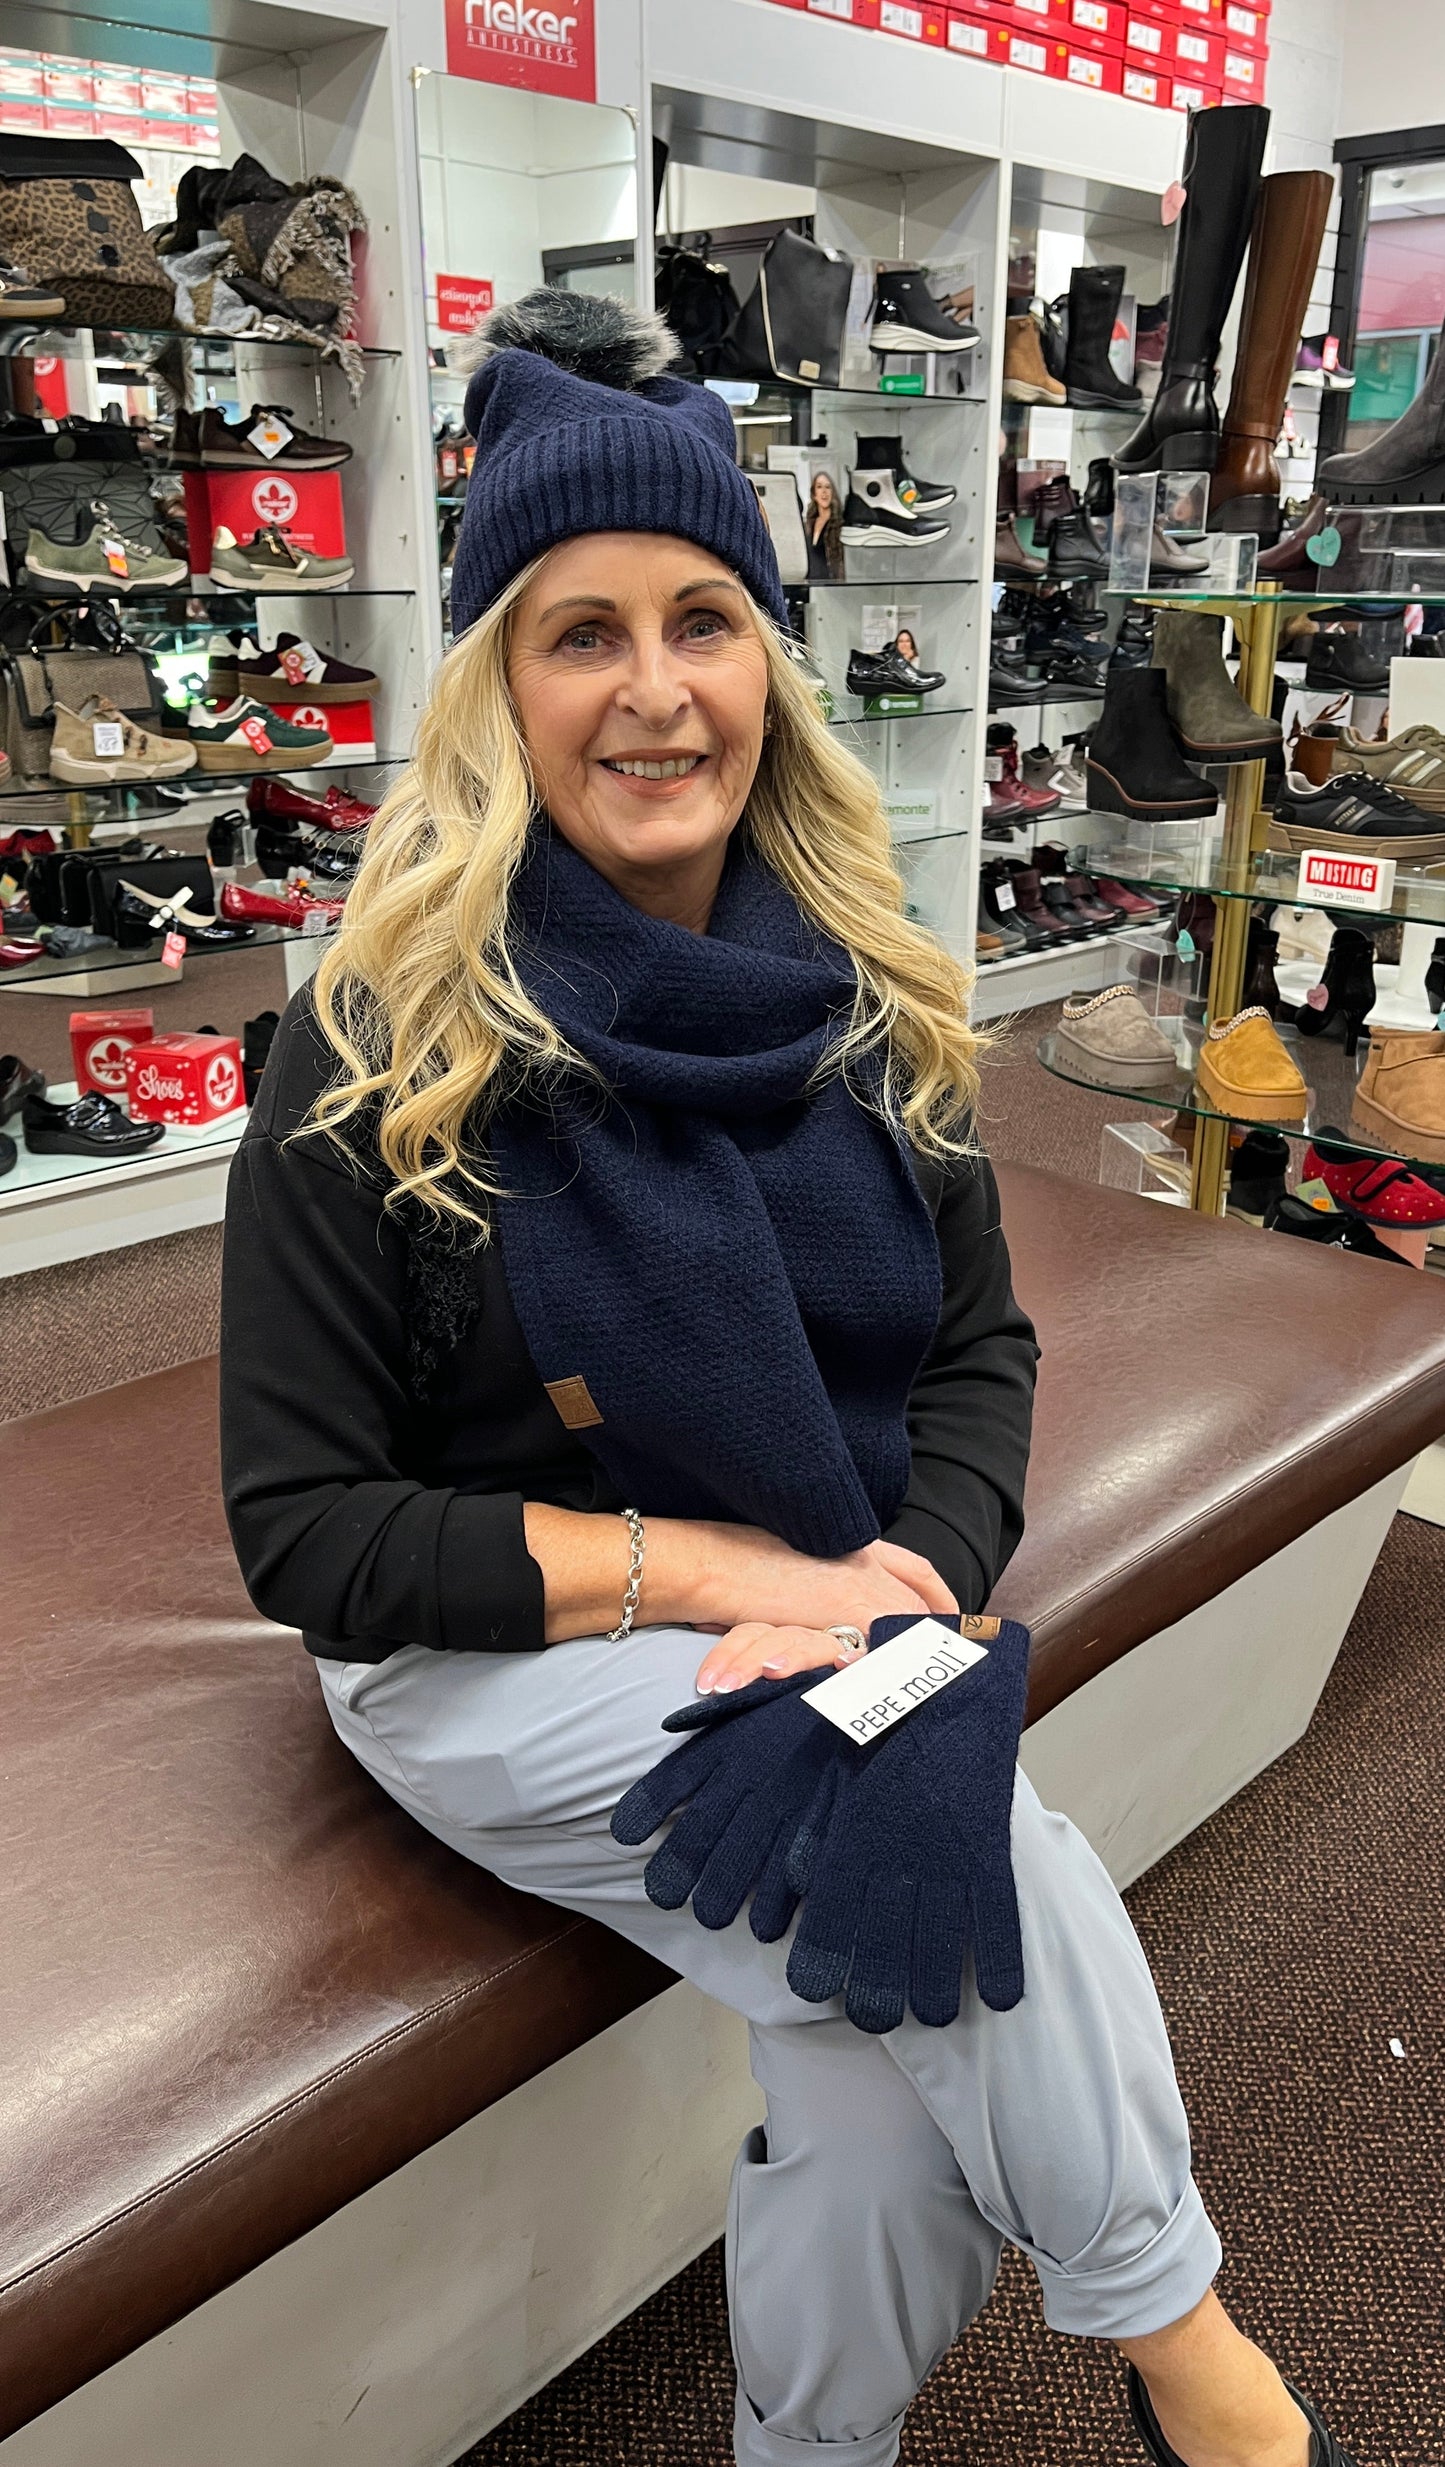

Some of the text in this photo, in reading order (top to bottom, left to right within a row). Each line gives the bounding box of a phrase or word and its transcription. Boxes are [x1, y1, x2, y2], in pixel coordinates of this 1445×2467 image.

[465, 0, 578, 44] rieker
[467, 28, 575, 64] ANTISTRESS
[1309, 860, 1374, 889] MUSTANG
[1313, 888, 1365, 904] True Denim
[136, 1064, 185, 1101] Shoes
[849, 1650, 968, 1738] PEPE moll
